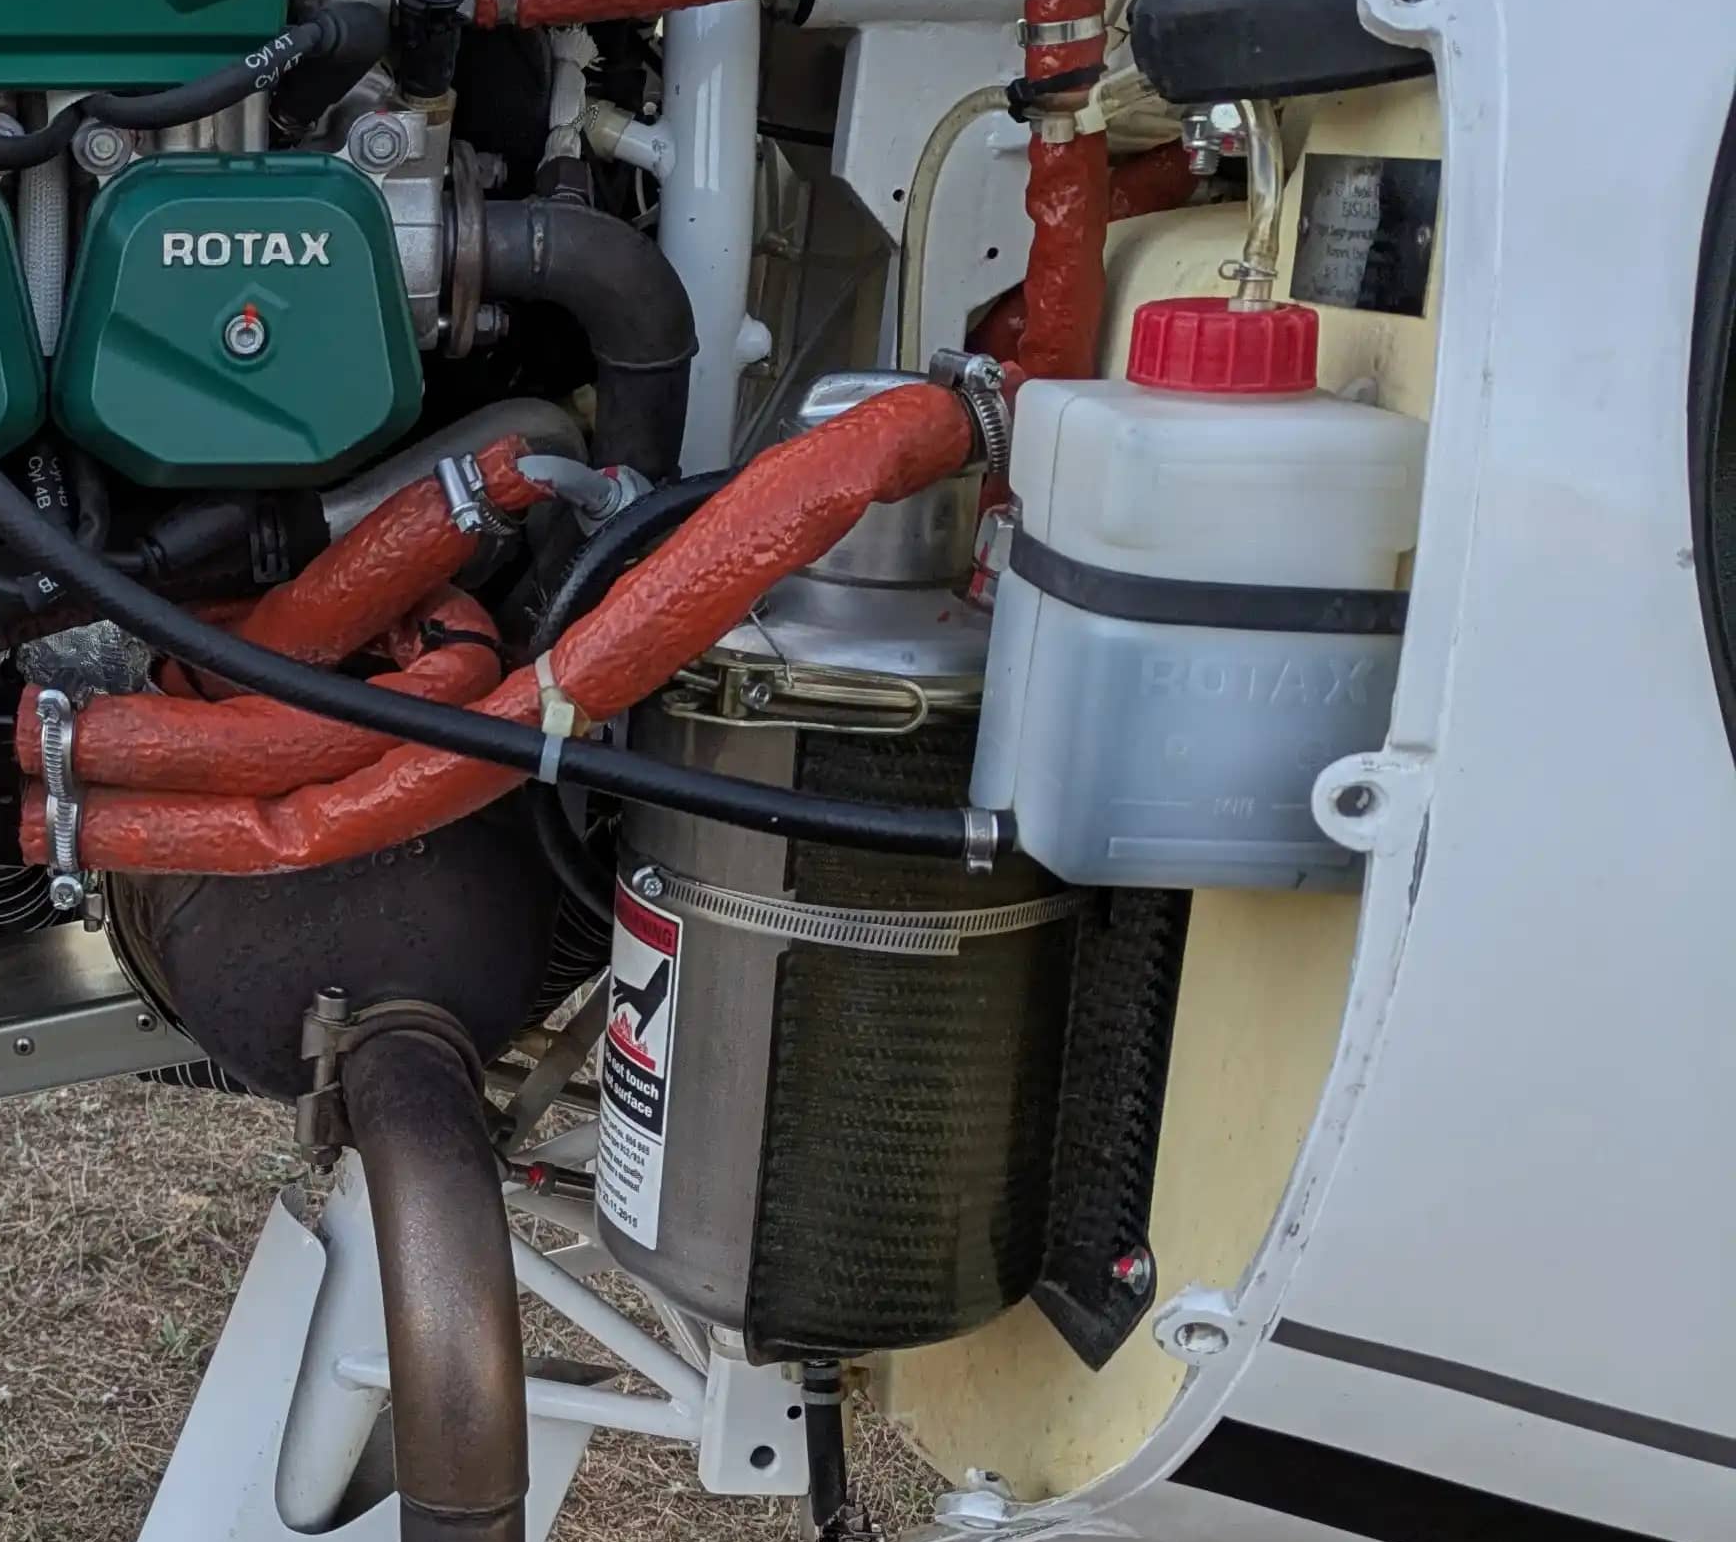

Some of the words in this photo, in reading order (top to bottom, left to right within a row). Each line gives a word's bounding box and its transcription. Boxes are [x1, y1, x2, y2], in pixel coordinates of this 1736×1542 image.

[245, 45, 274, 69] Cyl
[274, 32, 294, 50] 4T
[163, 232, 331, 266] ROTAX
[28, 455, 46, 483] Cyl
[34, 486, 52, 510] 4B
[1140, 657, 1374, 706] ROTAX
[613, 1083, 653, 1118] surface
[626, 1069, 659, 1100] touch
